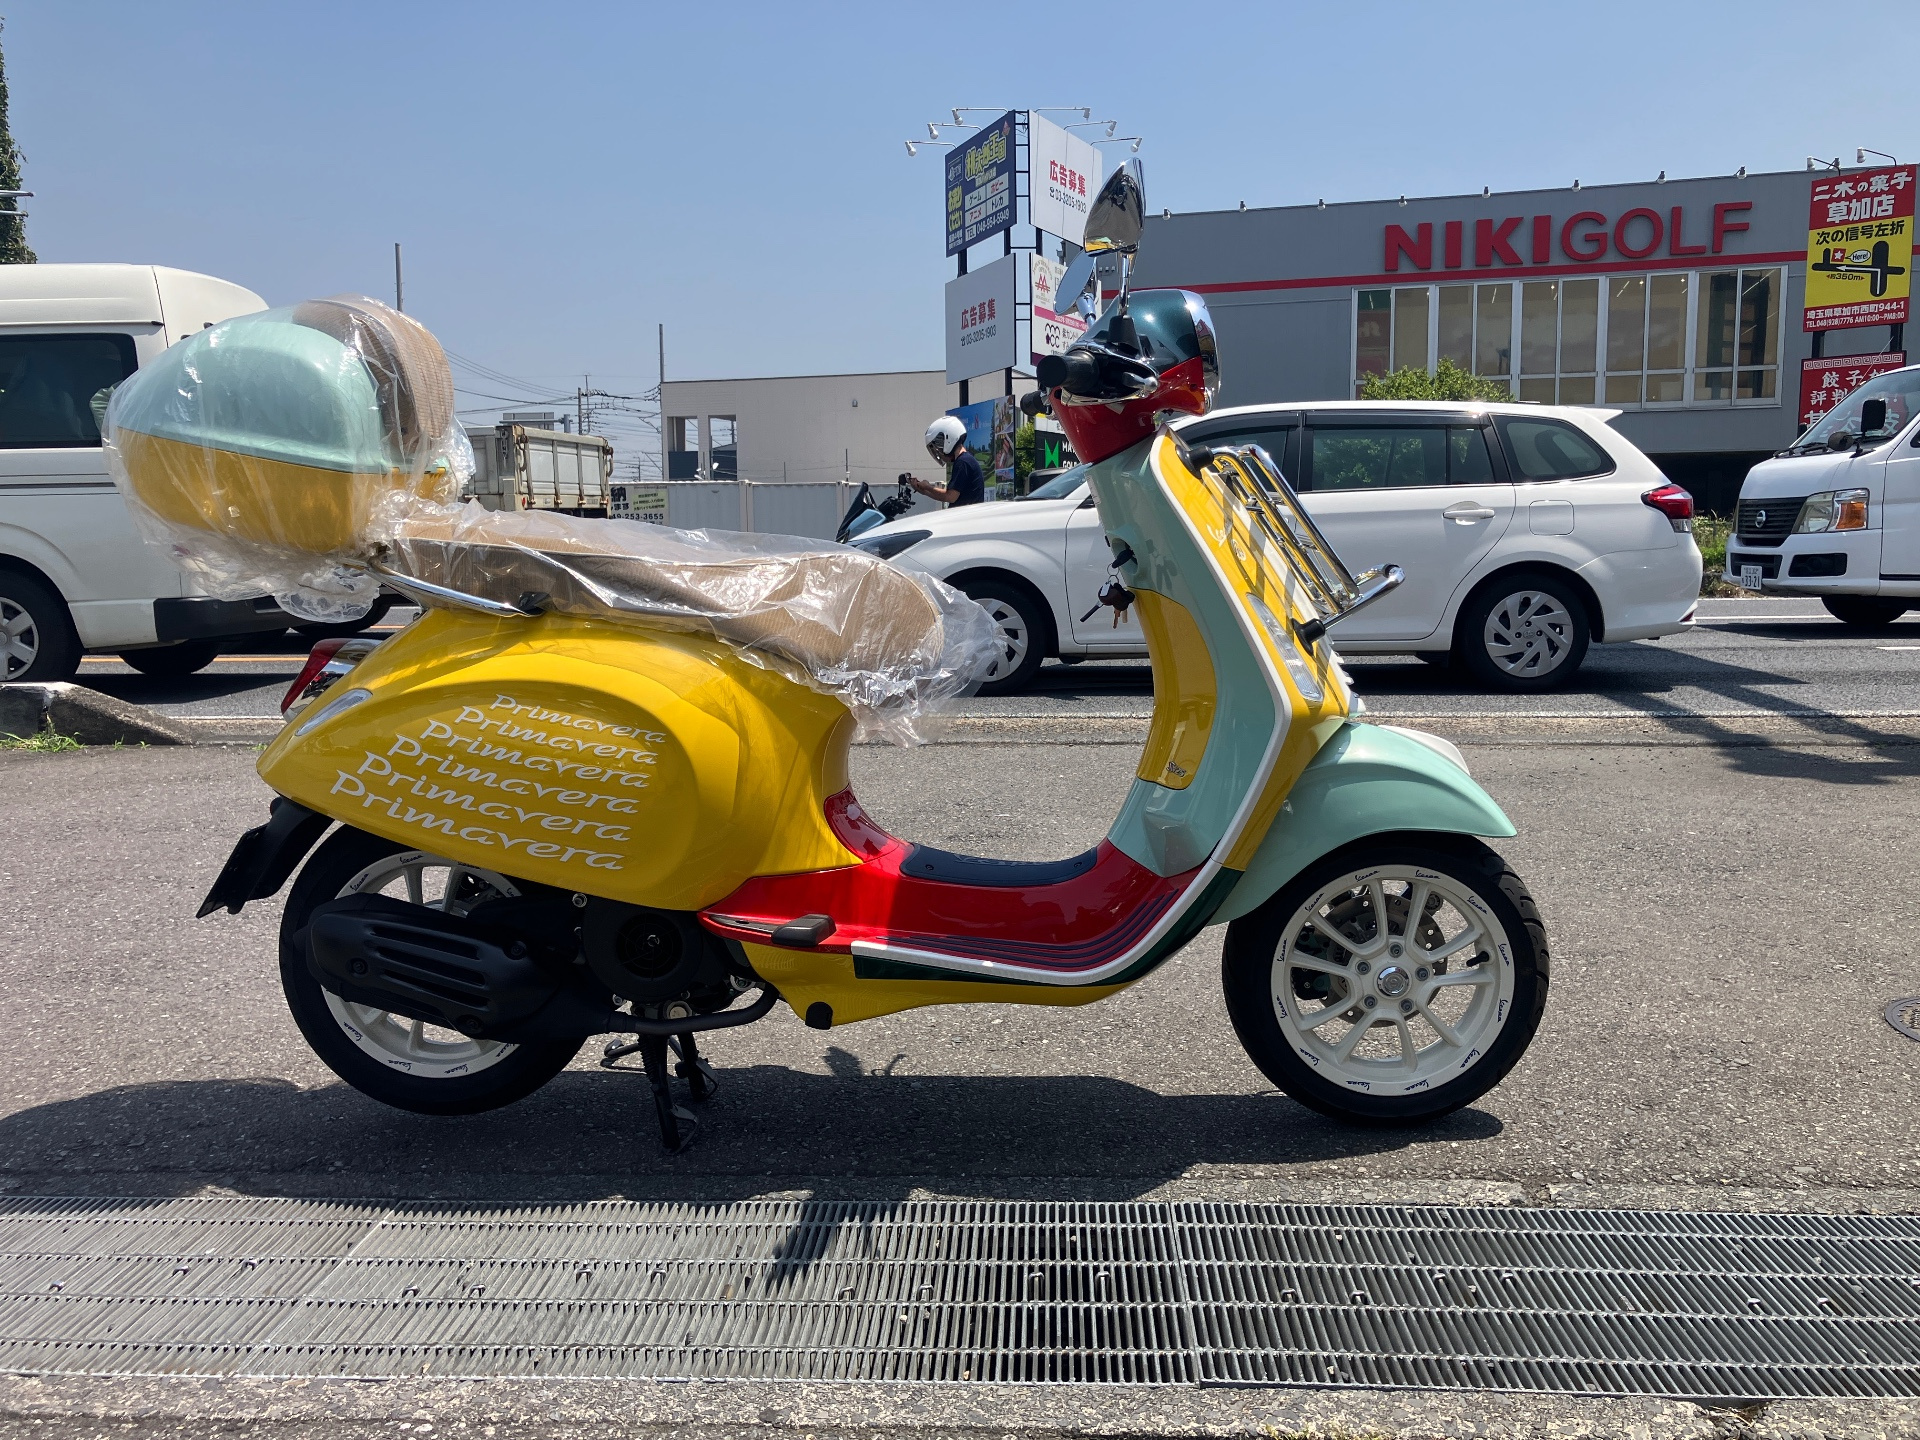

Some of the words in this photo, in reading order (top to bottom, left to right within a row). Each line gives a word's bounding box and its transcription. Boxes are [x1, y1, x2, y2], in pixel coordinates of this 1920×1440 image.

[1050, 160, 1086, 197] 広告募集
[1813, 171, 1913, 202] 二木の菓子
[969, 190, 982, 206] ゲーム
[969, 207, 982, 222] アニメ
[1827, 194, 1895, 224] 草加店
[1816, 220, 1905, 245] 次の信号左折
[1852, 253, 1869, 261] Here!
[961, 298, 995, 330] 広告募集
[454, 706, 657, 765] Primavera
[490, 694, 666, 743] Primavera
[420, 719, 650, 788] Primavera
[387, 734, 640, 814] Primavera
[357, 751, 631, 841] Primavera
[330, 770, 624, 870] Primavera
